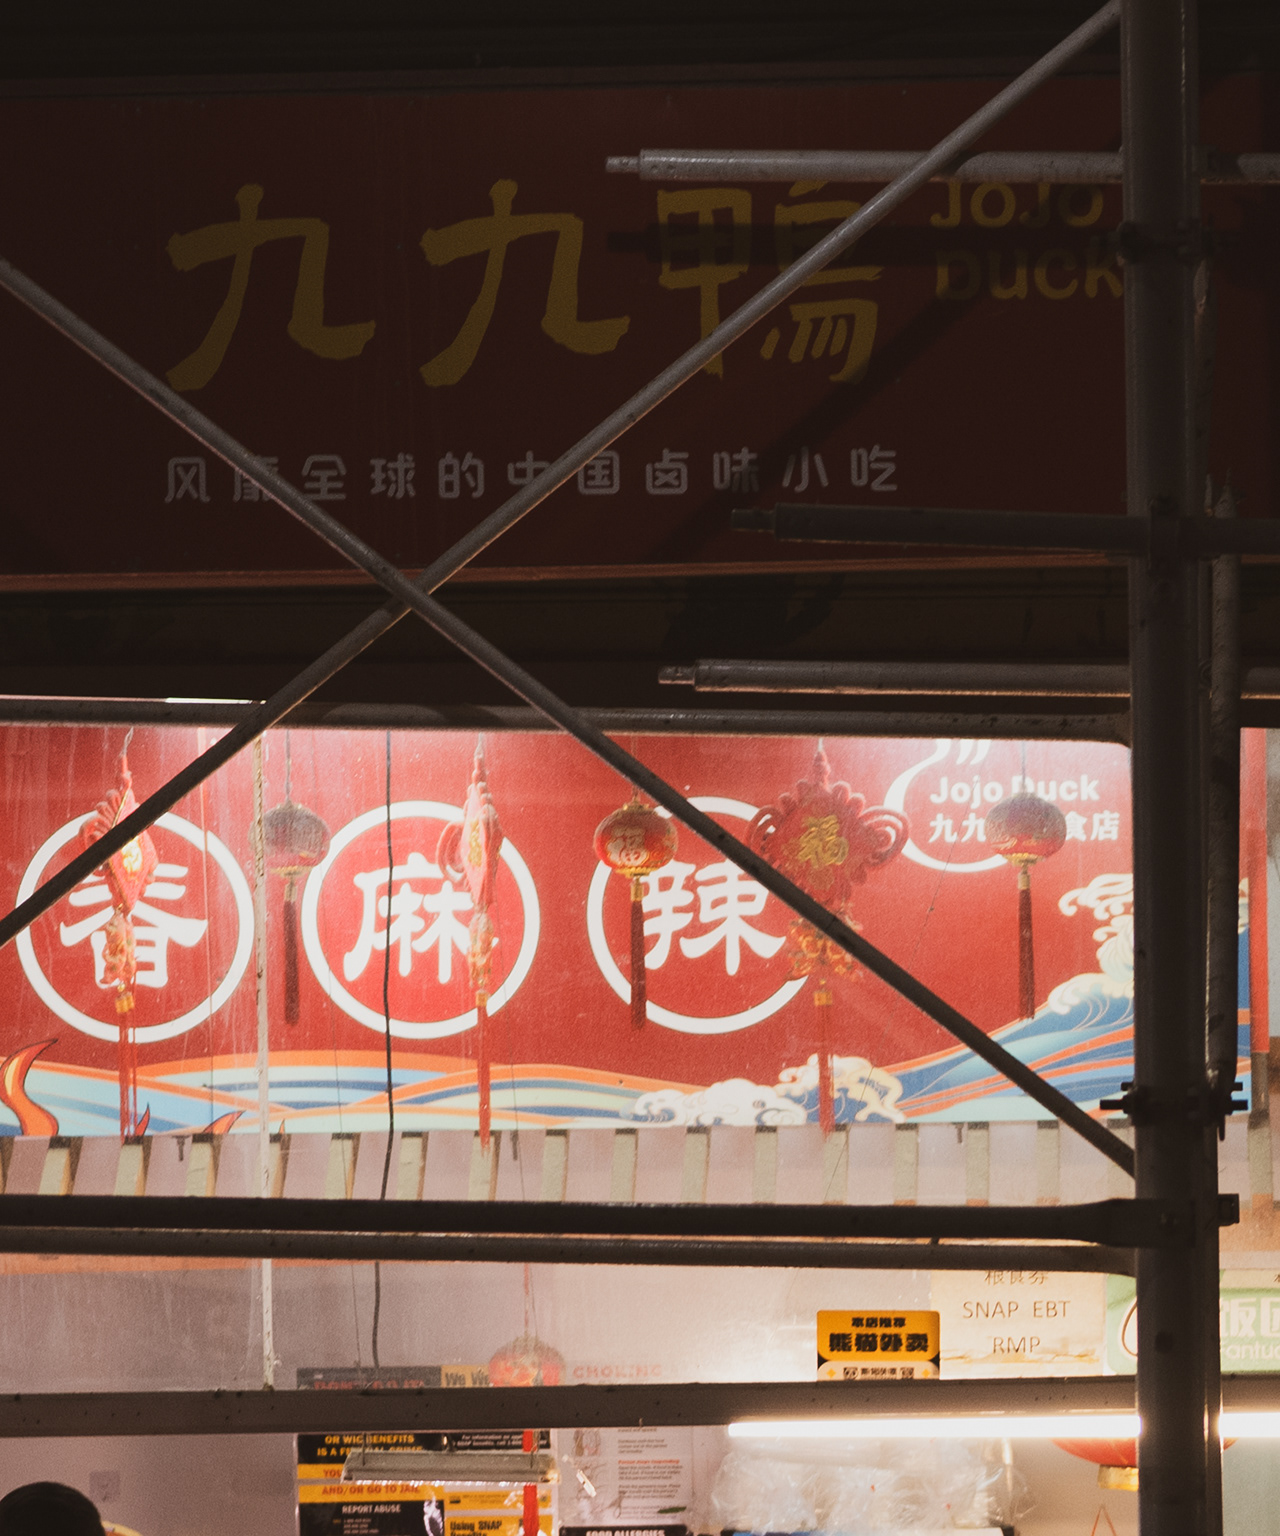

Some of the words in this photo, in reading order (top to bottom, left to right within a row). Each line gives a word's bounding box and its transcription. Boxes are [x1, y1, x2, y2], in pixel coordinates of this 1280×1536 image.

[929, 775, 1004, 809] Jojo
[927, 811, 1120, 843] 九九食店
[962, 1300, 1019, 1320] SNAP
[1032, 1299, 1071, 1318] EBT
[991, 1335, 1041, 1355] RMP
